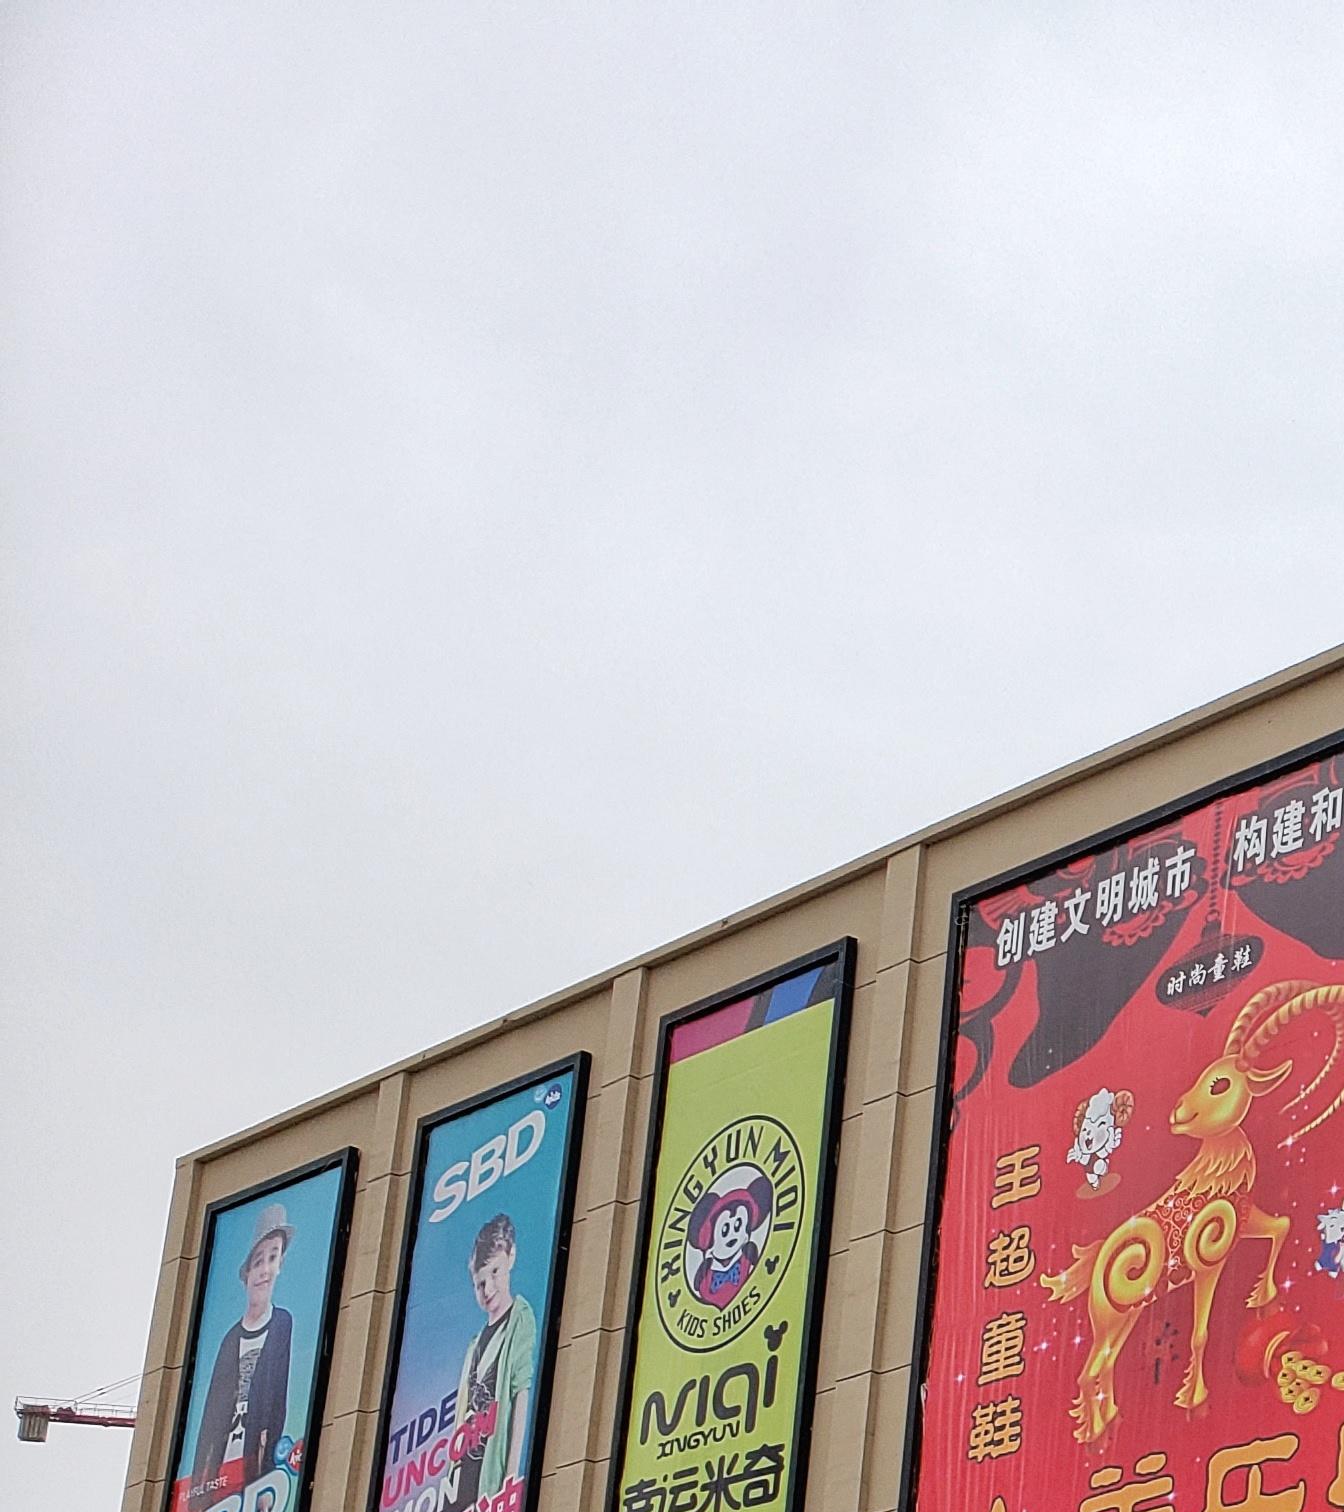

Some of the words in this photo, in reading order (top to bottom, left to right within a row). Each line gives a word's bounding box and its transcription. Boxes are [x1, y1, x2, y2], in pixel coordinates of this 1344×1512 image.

[995, 844, 1197, 968] 创建文明城市
[1166, 945, 1254, 997] 时尚童鞋
[428, 1109, 546, 1223] SBD
[676, 1308, 708, 1339] KIDS
[712, 1285, 761, 1337] SHOES
[967, 1143, 1043, 1465] 王超童鞋
[389, 1388, 459, 1466] TIDE
